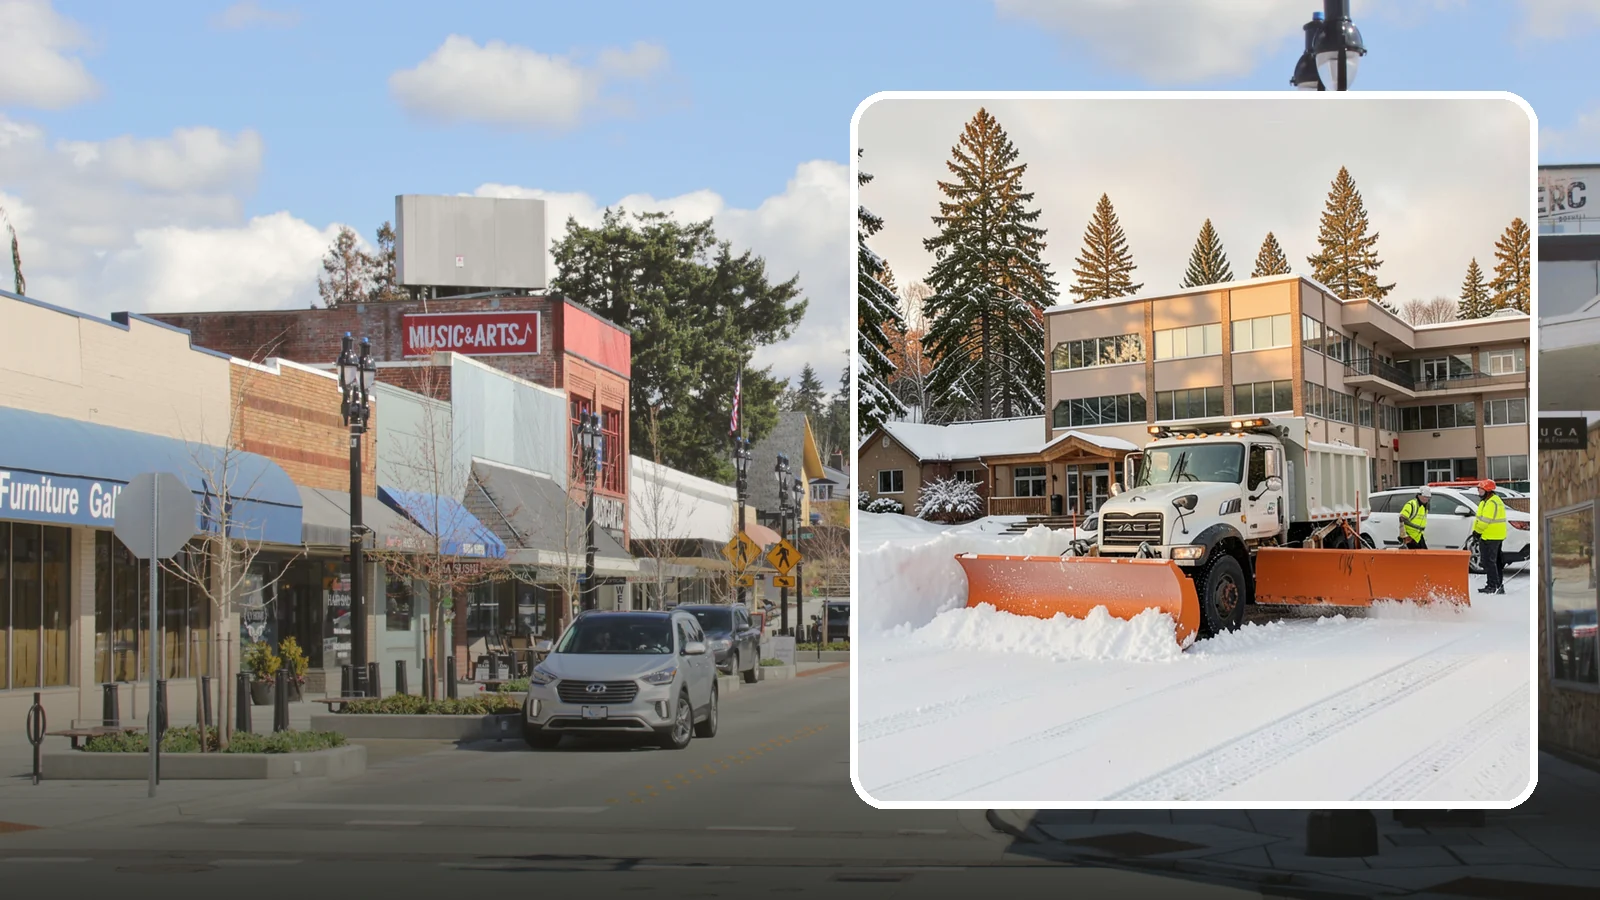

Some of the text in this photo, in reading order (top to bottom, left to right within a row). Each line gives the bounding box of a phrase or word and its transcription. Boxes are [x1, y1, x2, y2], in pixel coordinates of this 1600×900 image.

[409, 323, 519, 349] MUSIC&ARTS
[0, 472, 122, 519] Furniture Gal
[453, 563, 479, 574] SUSHI
